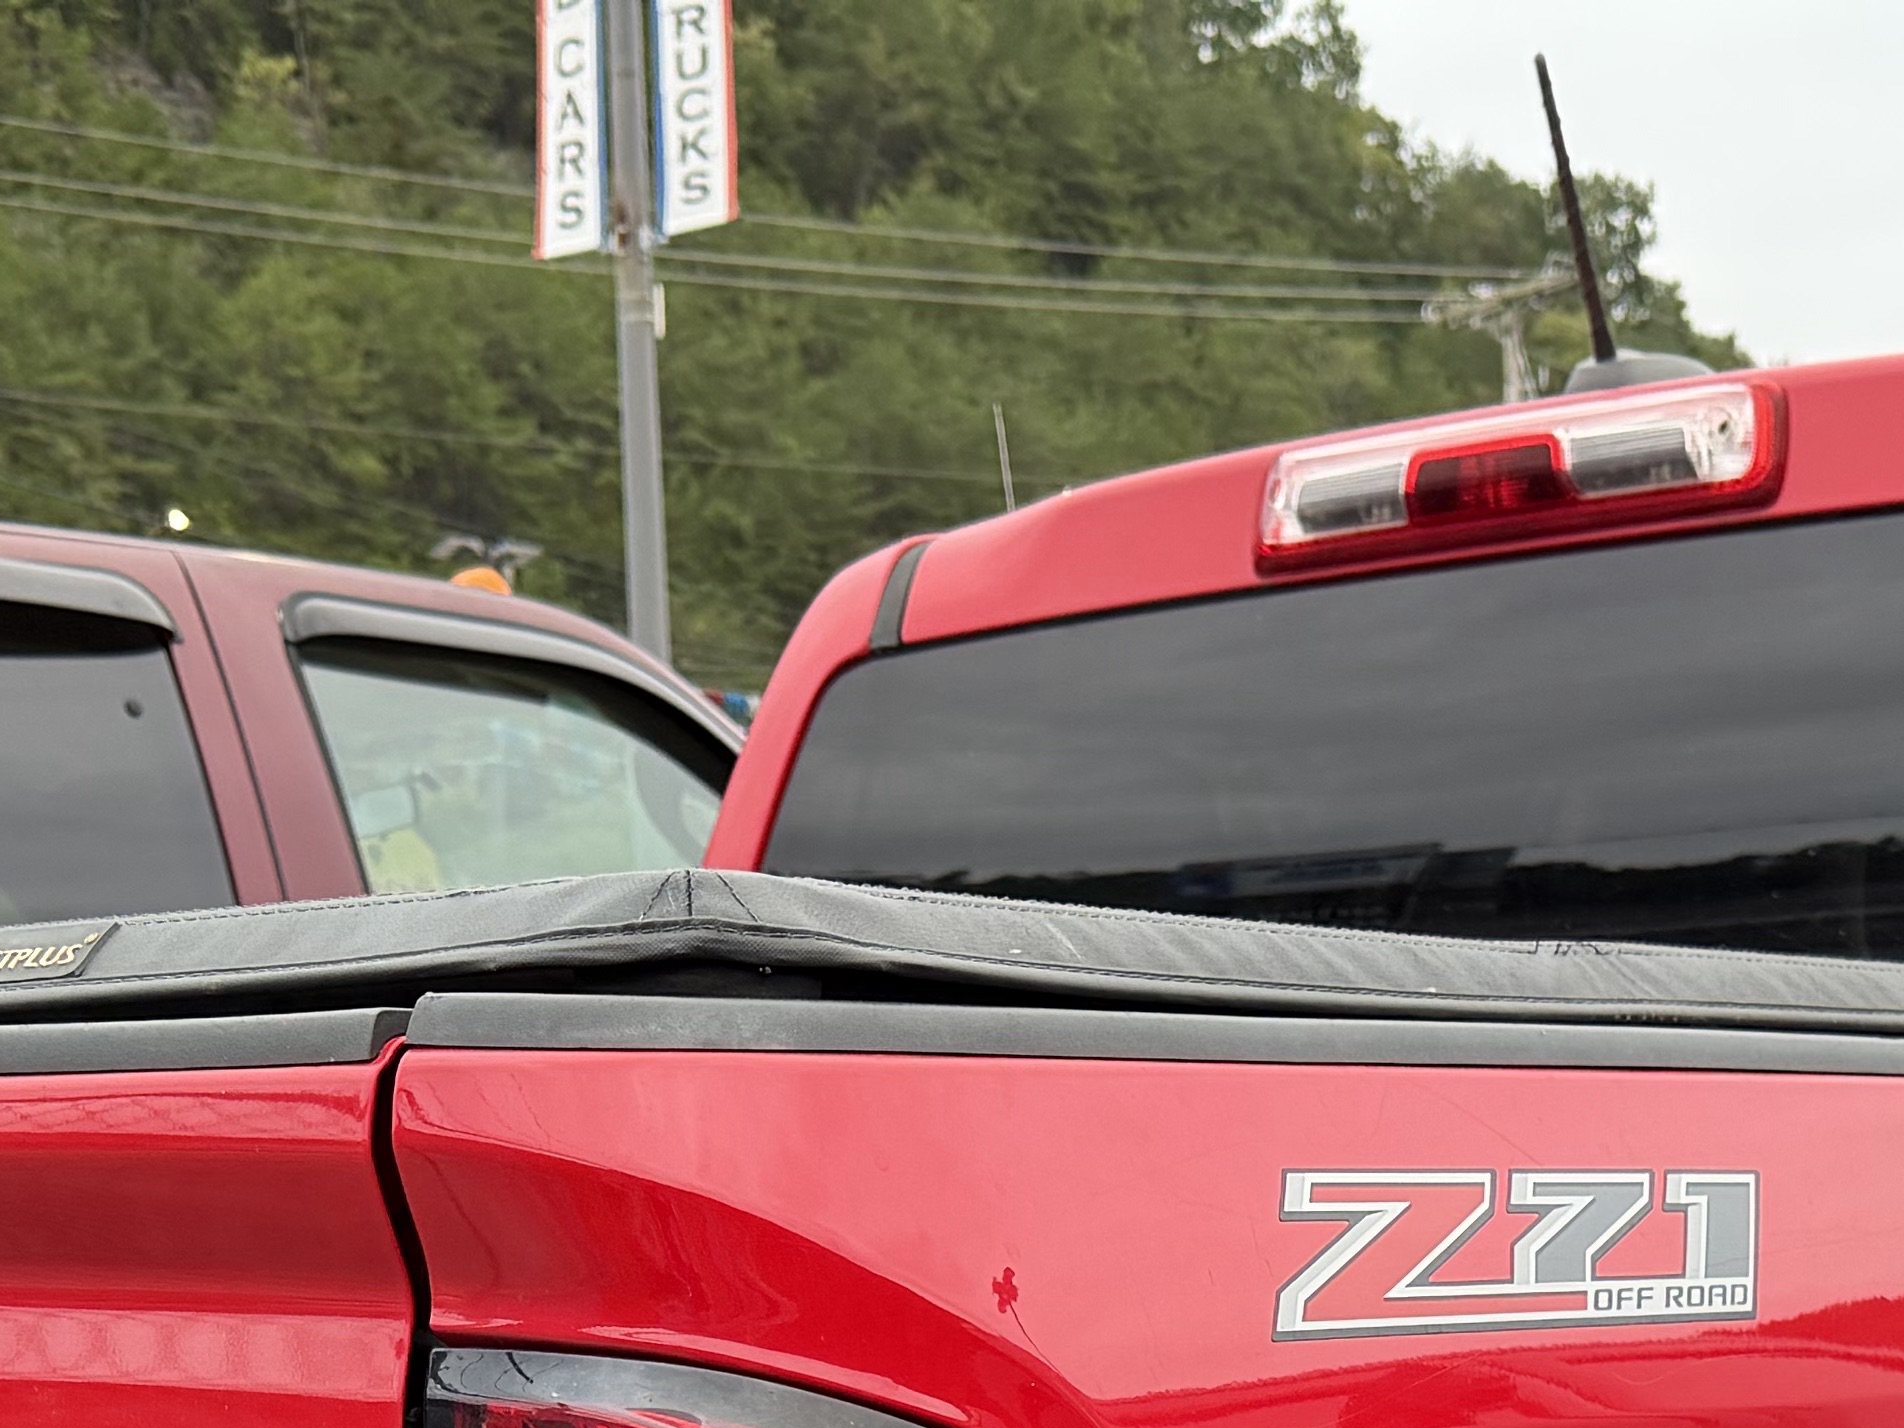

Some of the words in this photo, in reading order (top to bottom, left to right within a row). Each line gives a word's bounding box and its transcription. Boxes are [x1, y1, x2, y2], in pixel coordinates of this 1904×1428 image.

[552, 37, 586, 230] CARS
[1272, 1168, 1760, 1342] Z71
[1593, 1288, 1654, 1311] OFF
[1664, 1284, 1749, 1308] ROAD
